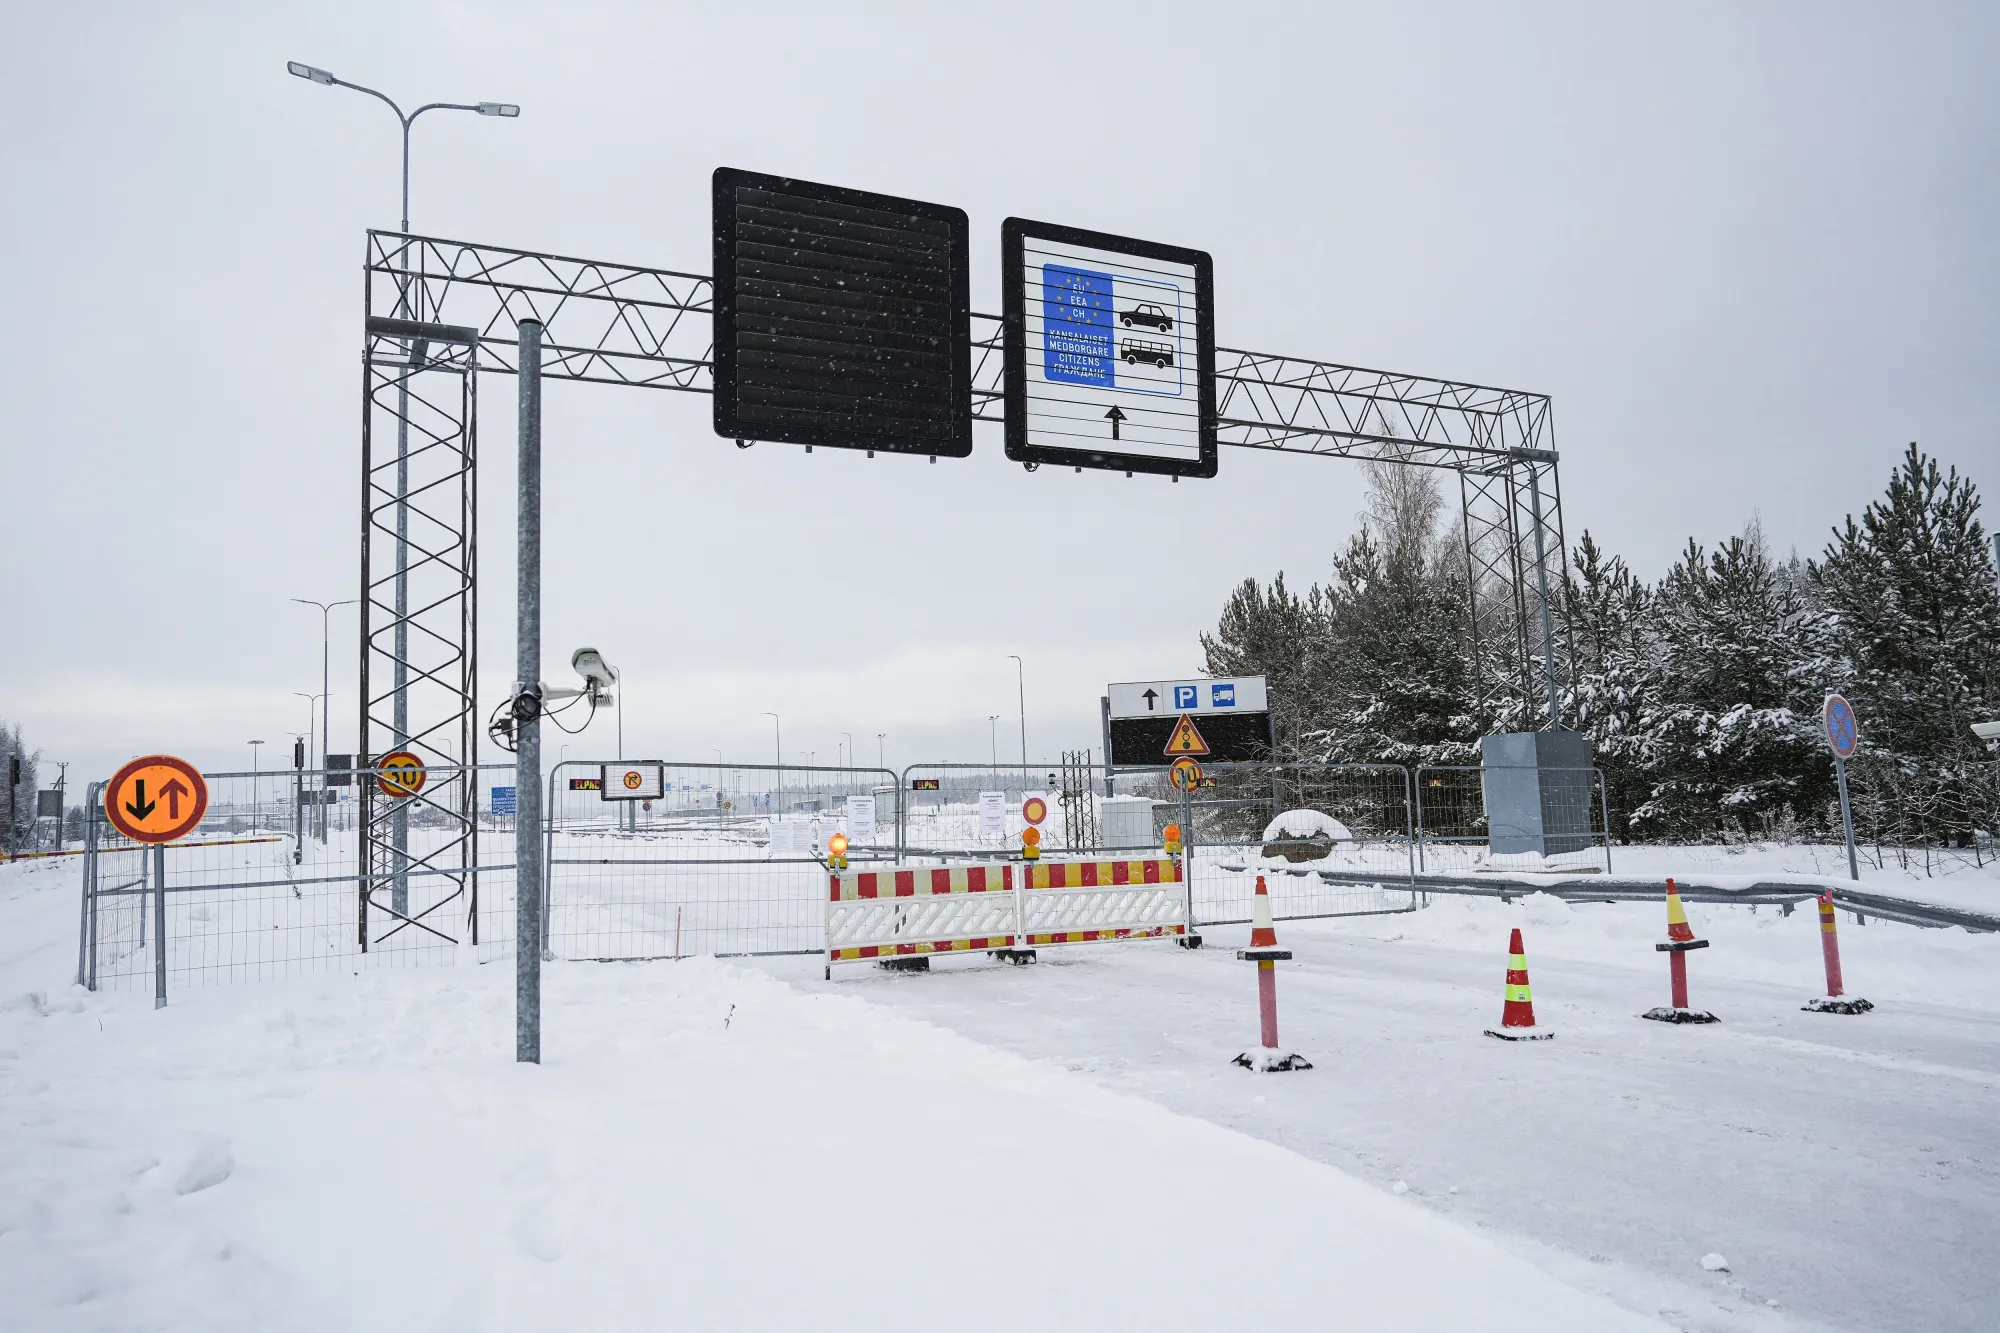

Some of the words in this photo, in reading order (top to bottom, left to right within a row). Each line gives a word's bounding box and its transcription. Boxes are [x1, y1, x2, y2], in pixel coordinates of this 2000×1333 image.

[1072, 283, 1085, 294] EU
[1070, 295, 1088, 307] EEA
[1072, 308, 1085, 319] CH
[1049, 329, 1109, 346] KANSALAISET
[1049, 340, 1109, 357] MEDBORGARE
[1059, 353, 1100, 367] CITIZENS
[1053, 363, 1106, 379] ГРАЖДАНЕ
[1178, 687, 1194, 708] P
[386, 763, 417, 786] 30
[574, 780, 601, 790] ELPAC
[917, 780, 938, 790] ELPAC
